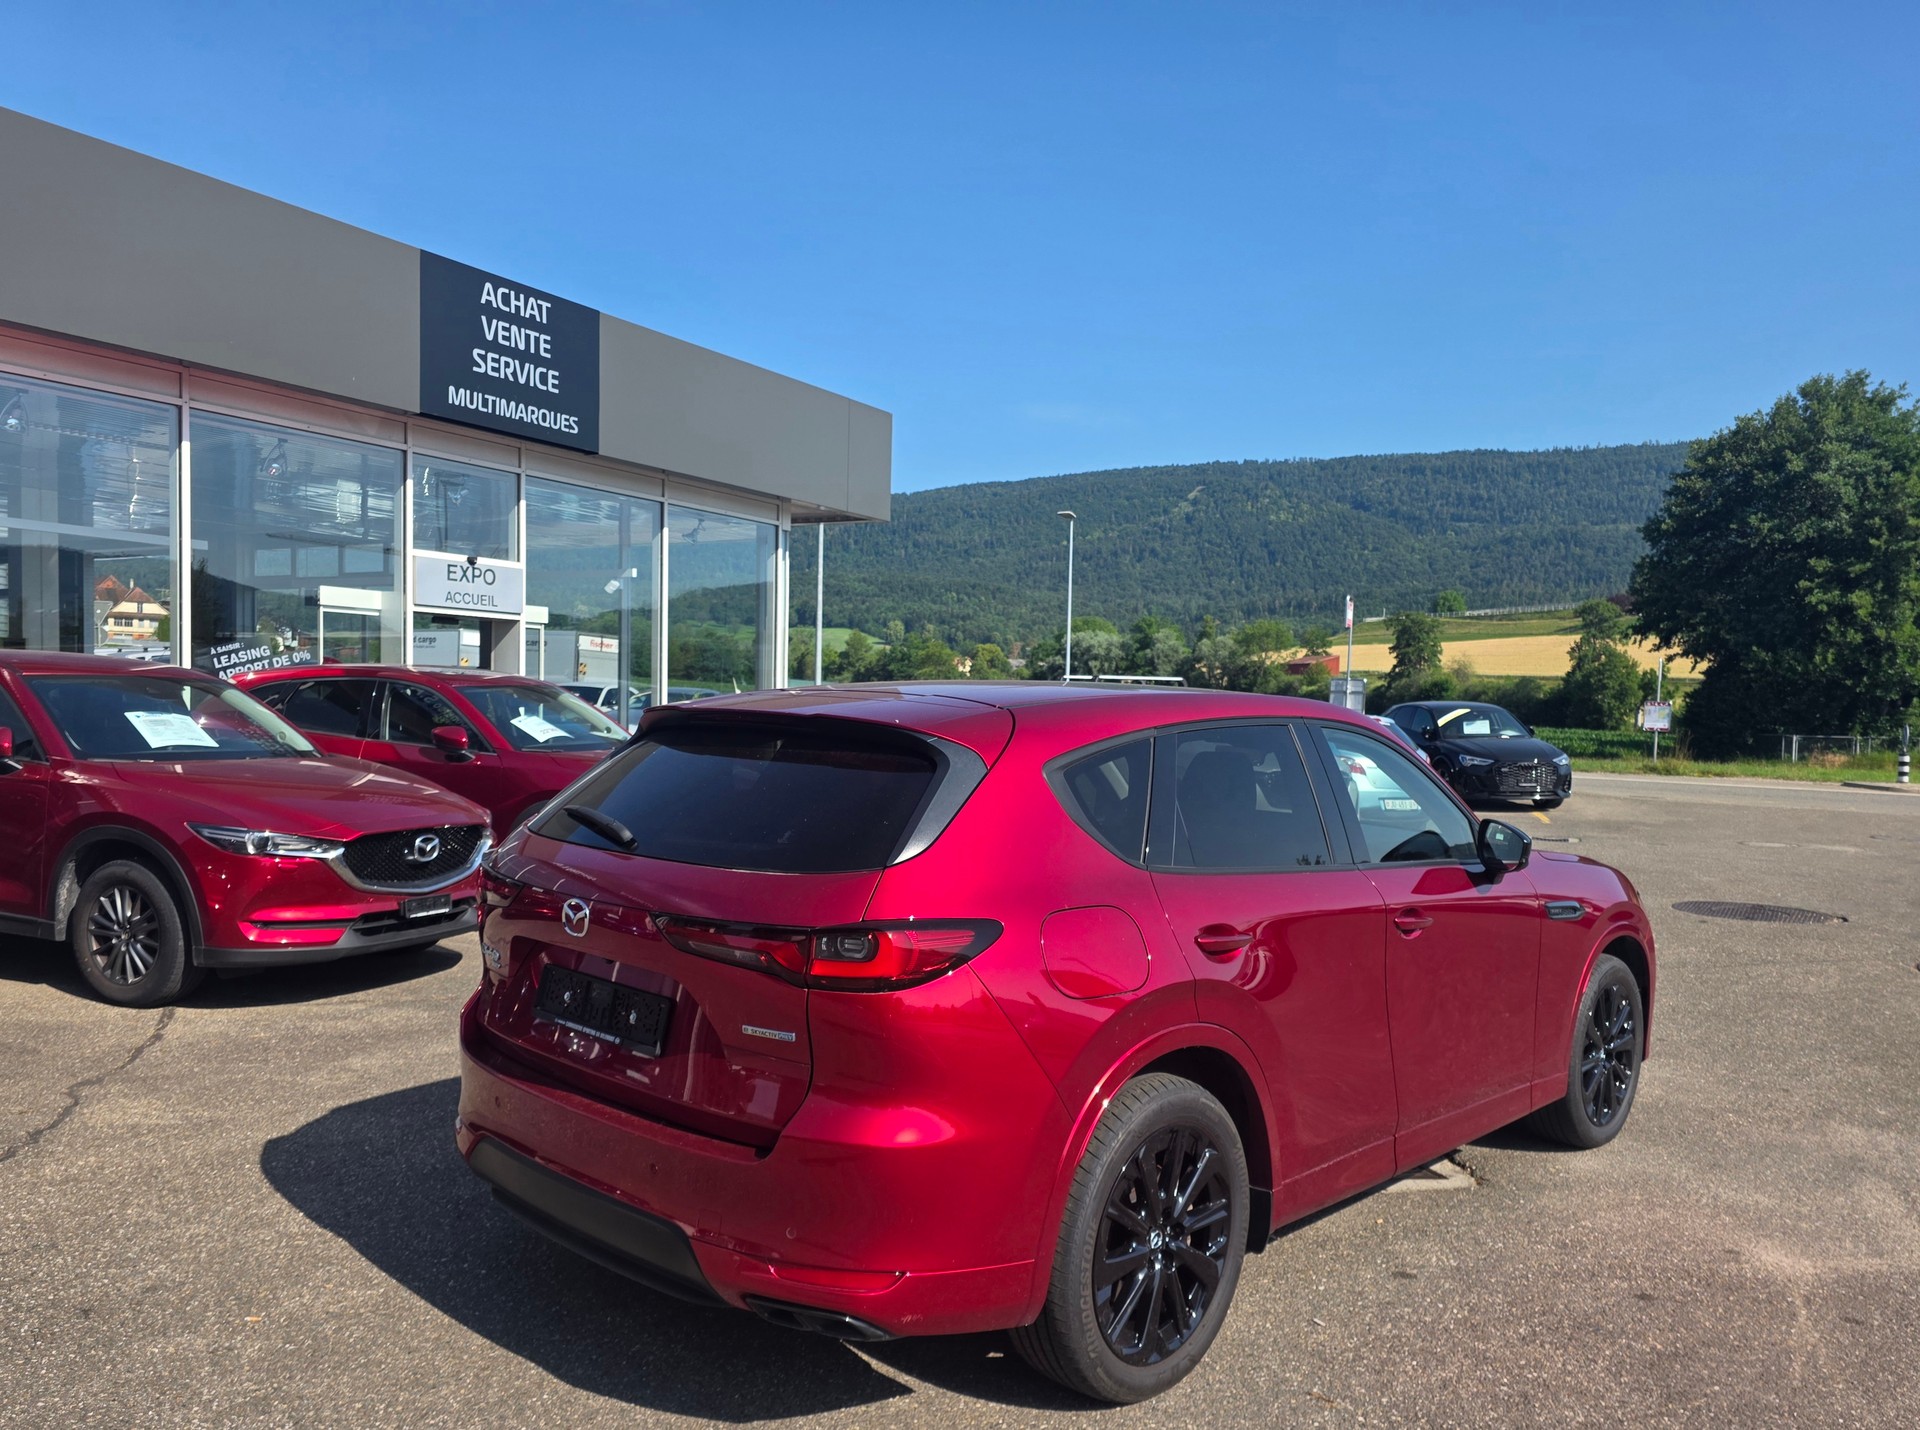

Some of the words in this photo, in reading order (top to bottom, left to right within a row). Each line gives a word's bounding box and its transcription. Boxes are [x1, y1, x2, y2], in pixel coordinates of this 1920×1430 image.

[480, 282, 551, 324] ACHAT
[481, 315, 551, 358] VENTE
[472, 348, 559, 393] SERVICE
[448, 385, 579, 434] MULTIMARQUES
[446, 563, 497, 586] EXPO
[445, 591, 498, 607] ACCUEIL
[216, 642, 240, 653] SAISIR
[417, 636, 437, 645] cargo
[213, 645, 271, 669] LEASING
[272, 655, 291, 668] DE
[292, 649, 311, 663] 0%
[1079, 1213, 1100, 1360] BRIDGESTONE
